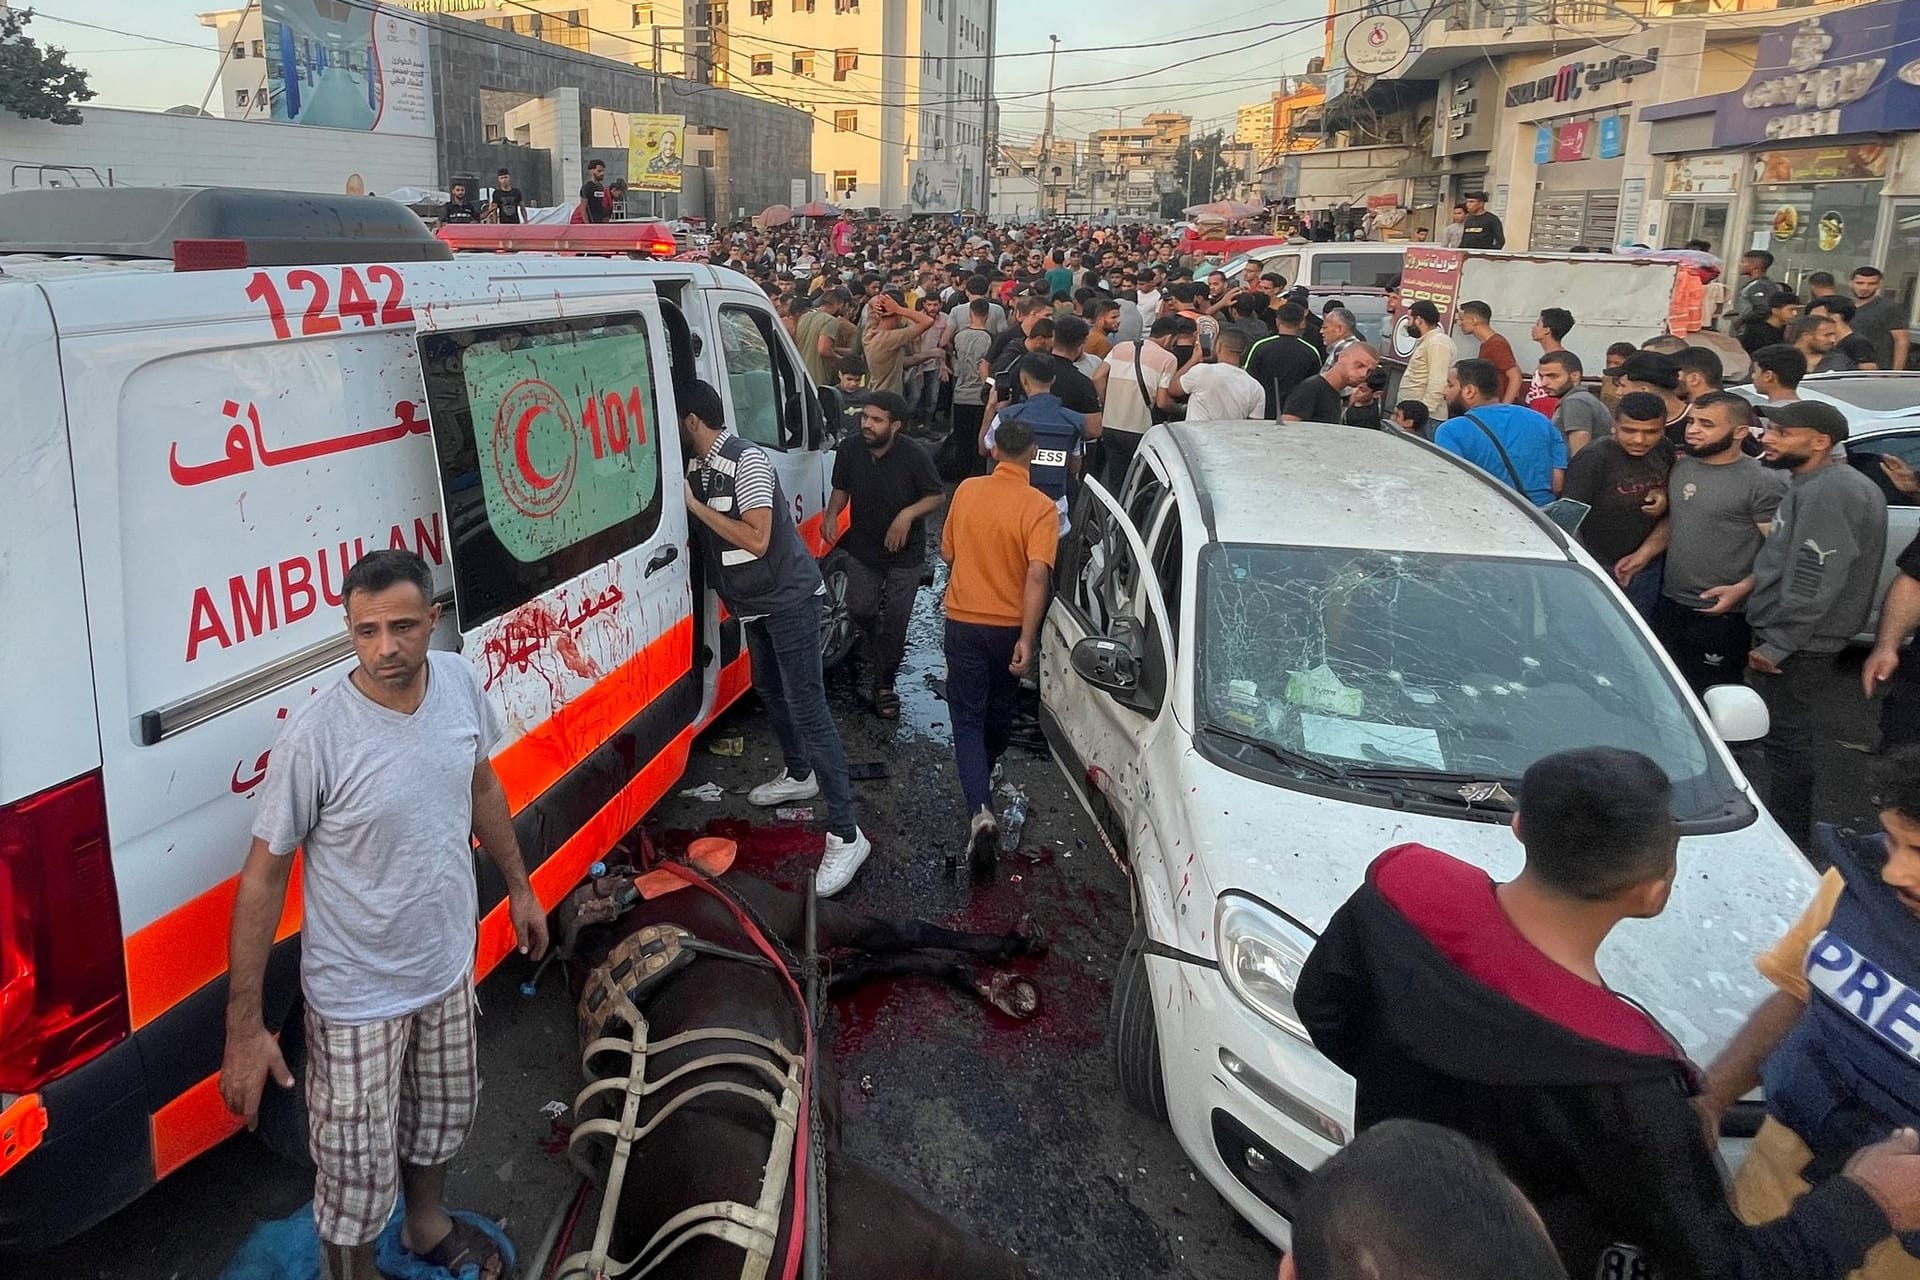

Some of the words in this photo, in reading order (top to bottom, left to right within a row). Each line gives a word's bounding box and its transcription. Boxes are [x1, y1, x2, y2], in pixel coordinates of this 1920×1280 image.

[443, 0, 486, 12] BUILDING
[245, 265, 415, 339] 1242
[582, 386, 647, 459] 101
[1038, 451, 1063, 463] ESS
[559, 584, 623, 639] جمعية
